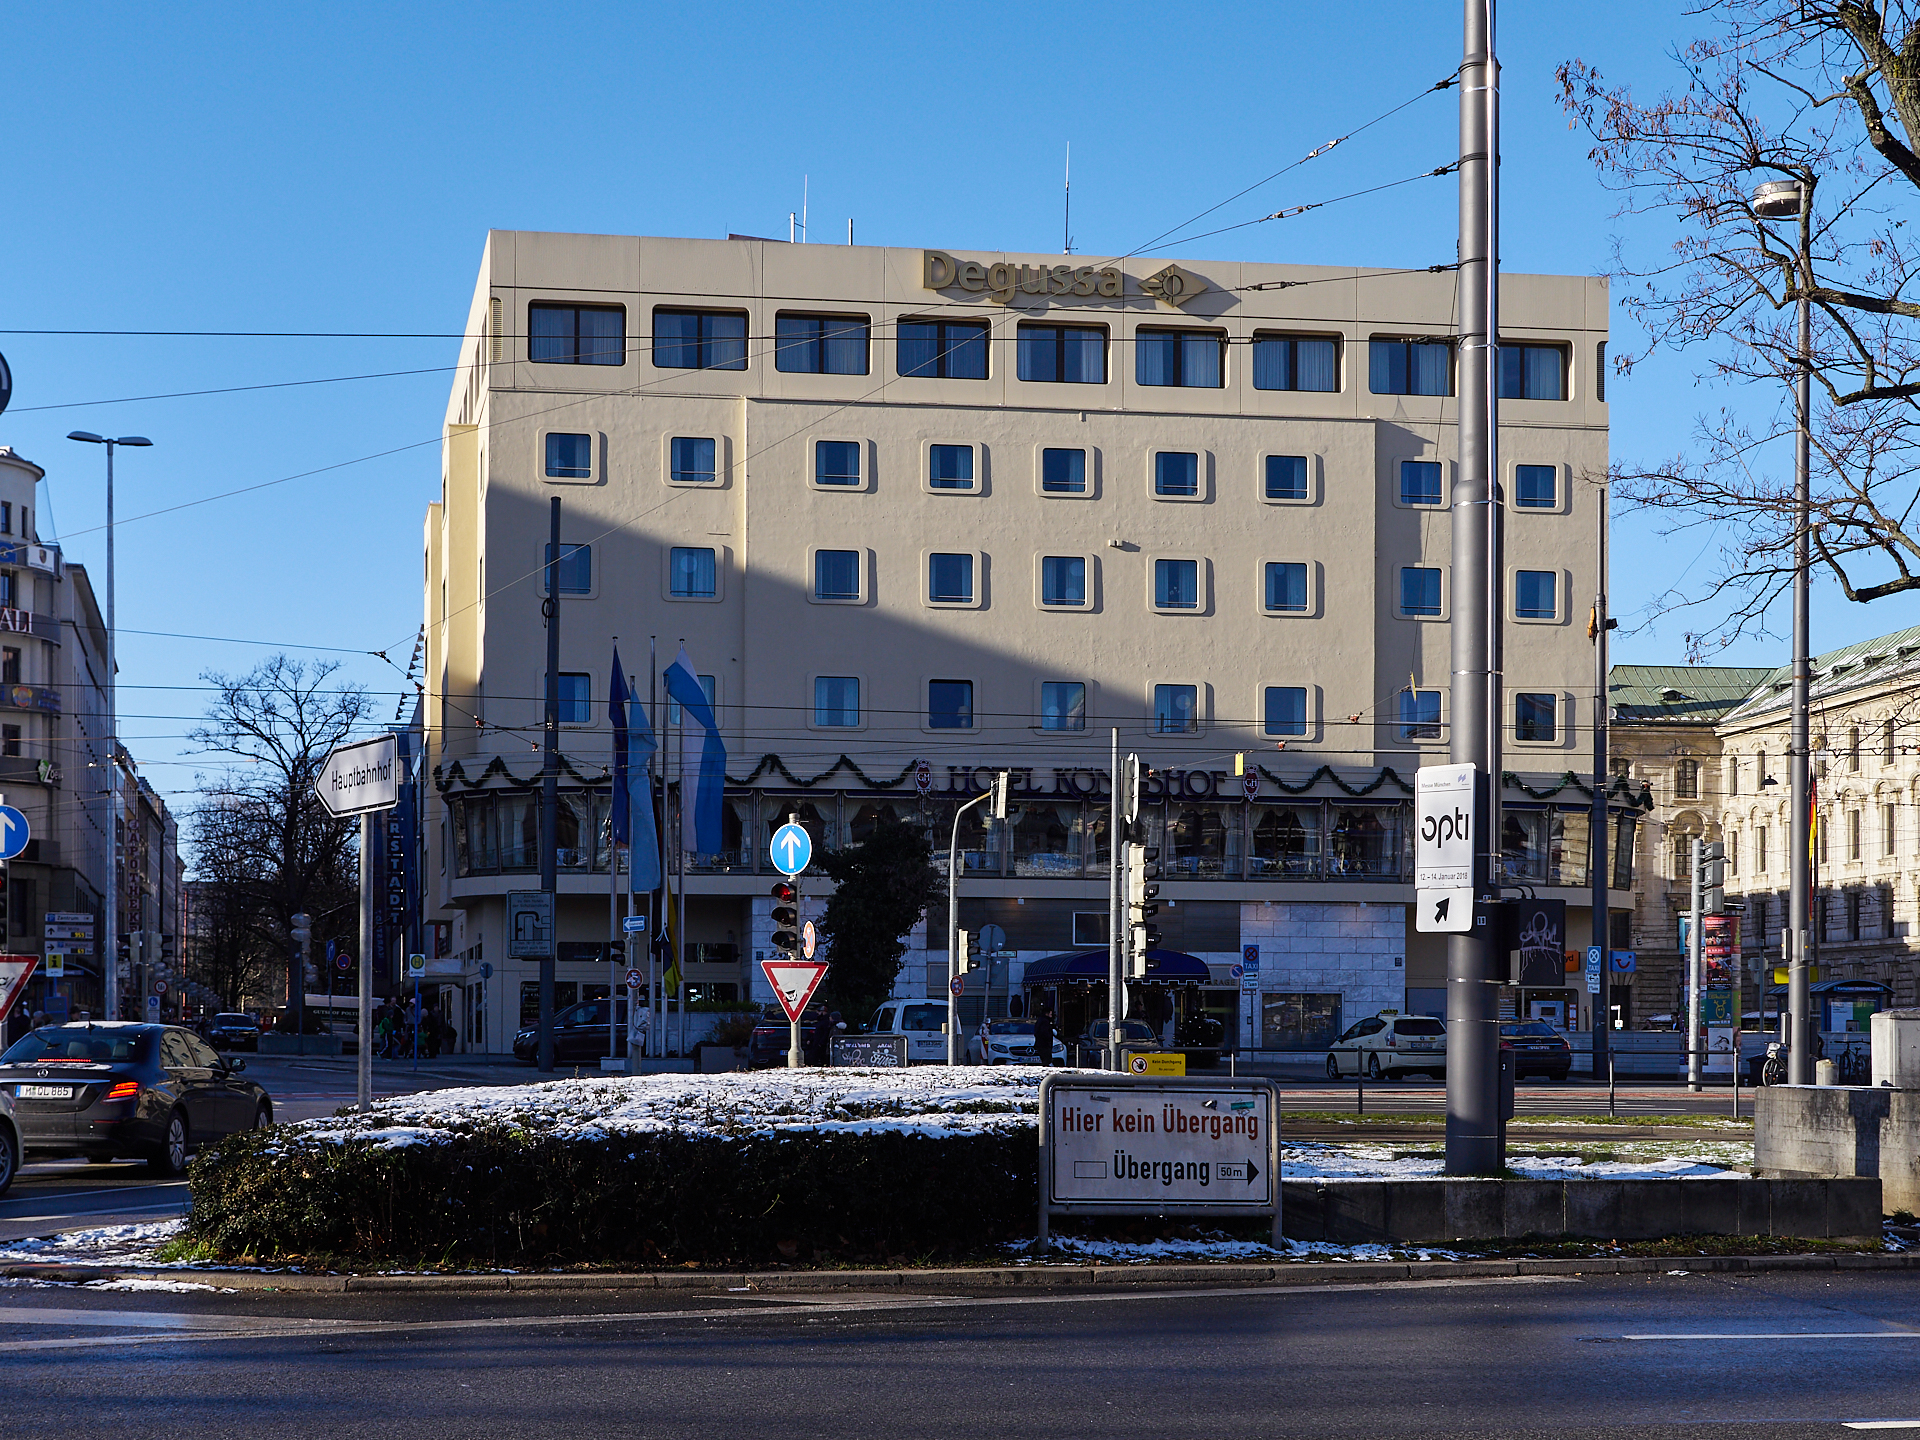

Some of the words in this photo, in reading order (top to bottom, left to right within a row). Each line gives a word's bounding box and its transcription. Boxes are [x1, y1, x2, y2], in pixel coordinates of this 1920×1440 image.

[922, 249, 1123, 305] Degussa
[332, 758, 391, 793] Hauptbahnhof
[1053, 767, 1227, 801] KÖNSHOF
[1421, 806, 1469, 848] opti
[128, 833, 139, 933] APOTHEKE
[389, 806, 401, 924] ARSTADT
[51, 1087, 69, 1096] 885
[1062, 1107, 1104, 1132] Hier
[1112, 1107, 1155, 1133] kein
[1162, 1103, 1259, 1141] Übergang
[1113, 1150, 1210, 1187] Übergang
[1220, 1166, 1232, 1177] 50
[1233, 1169, 1243, 1177] m
